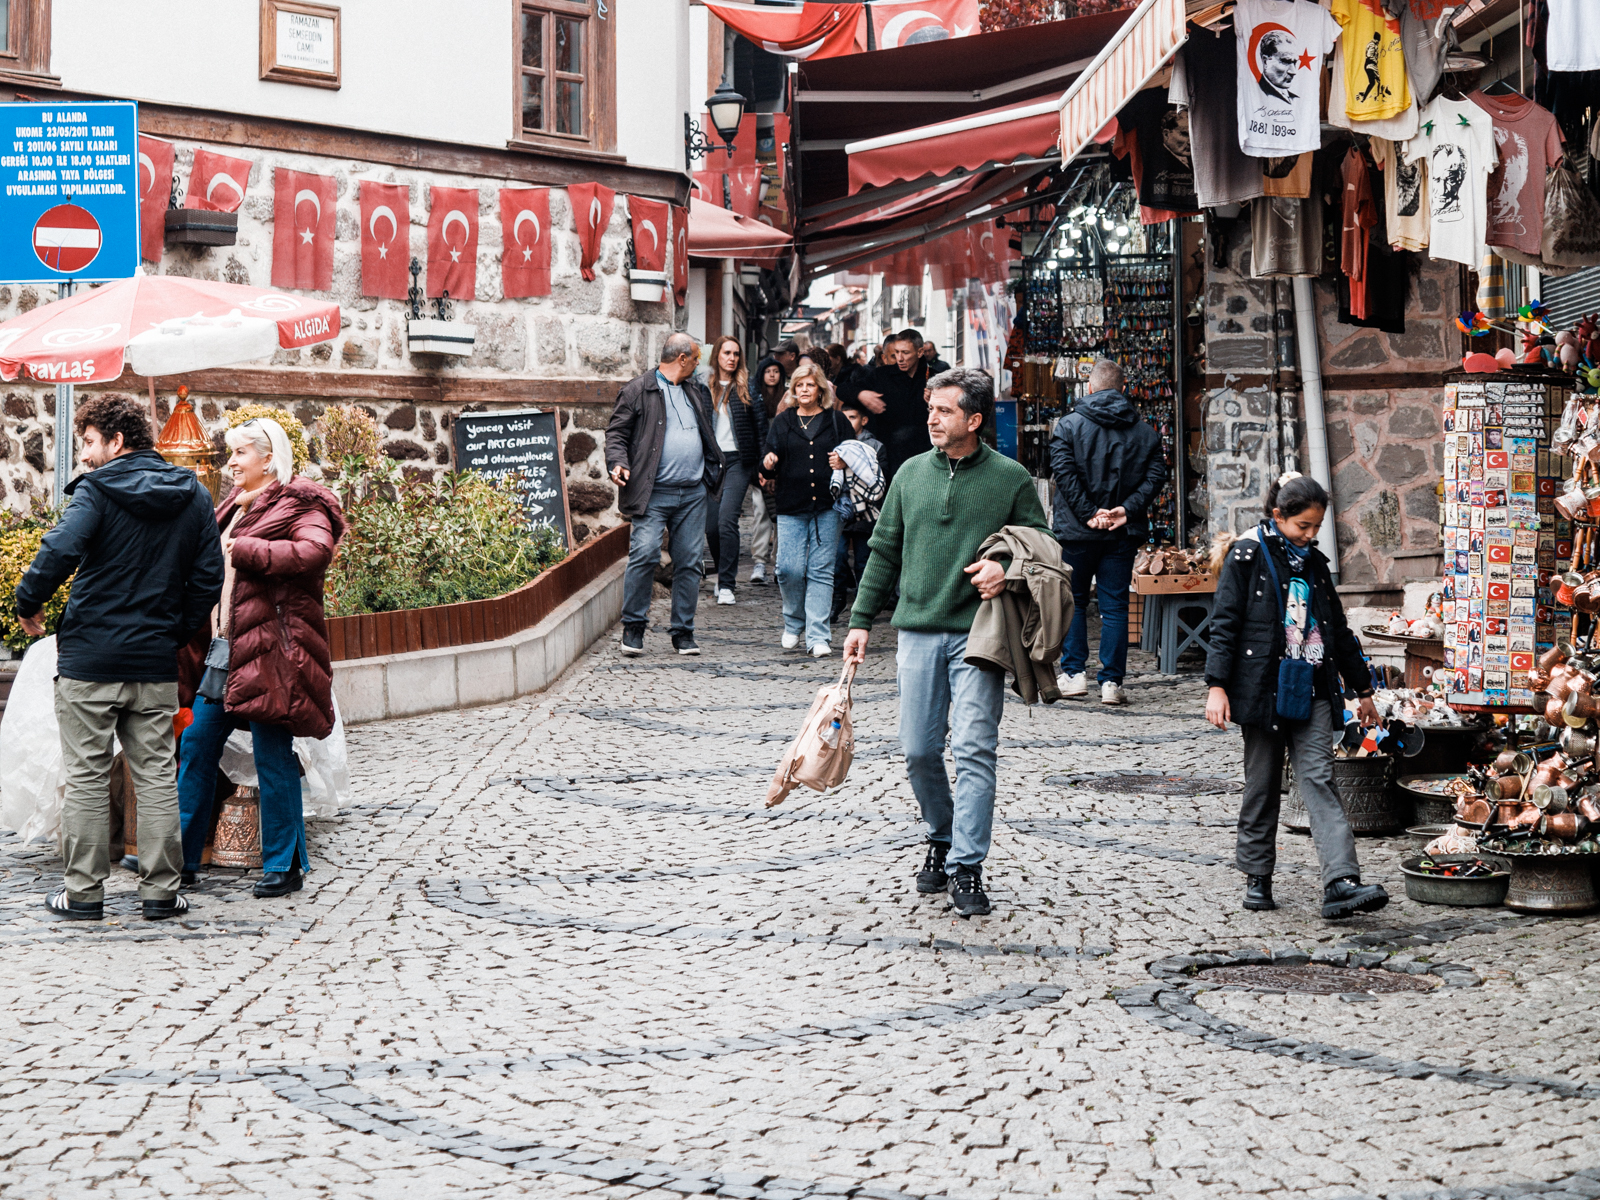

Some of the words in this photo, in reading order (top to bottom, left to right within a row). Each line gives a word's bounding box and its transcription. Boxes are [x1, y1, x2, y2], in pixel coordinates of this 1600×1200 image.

[291, 15, 319, 28] RAMAZAN
[42, 112, 53, 123] BU
[57, 112, 87, 122] ALANDA
[16, 127, 42, 138] UKOME
[47, 126, 88, 137] 23/05/2011
[1249, 120, 1267, 134] 1881
[14, 142, 23, 152] VE
[27, 142, 57, 152] 2011/06
[61, 141, 84, 151] SAYILI
[87, 141, 117, 151] KARARI
[32, 156, 52, 166] 10.00
[71, 156, 91, 166] 18.00
[18, 170, 56, 181] ARASINDA
[61, 170, 80, 180] YAYA
[7, 185, 57, 196] UYGULAMASI
[507, 419, 534, 431] visit
[471, 455, 488, 465] and
[527, 488, 557, 506] photo
